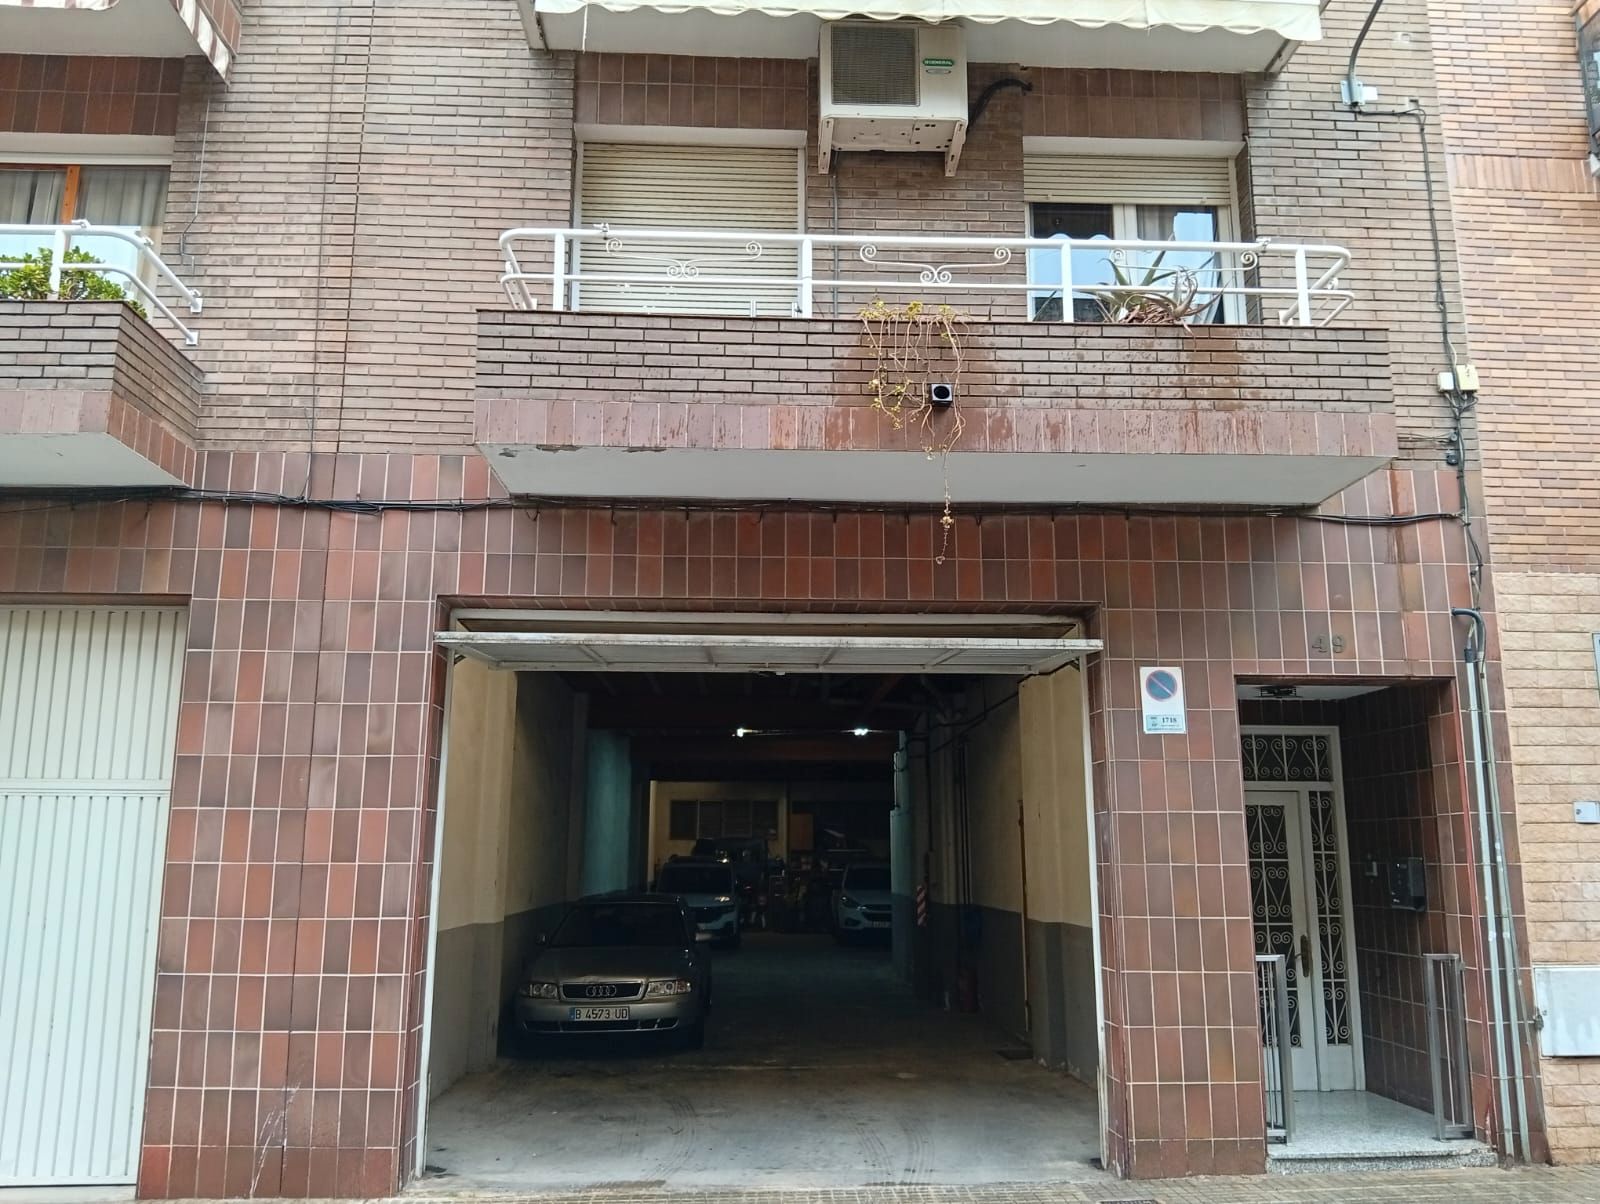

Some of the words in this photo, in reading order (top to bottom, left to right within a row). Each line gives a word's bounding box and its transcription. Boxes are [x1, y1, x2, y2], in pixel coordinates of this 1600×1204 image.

[575, 1009, 581, 1019] B
[585, 1008, 610, 1019] 4573
[615, 1008, 628, 1019] UD
